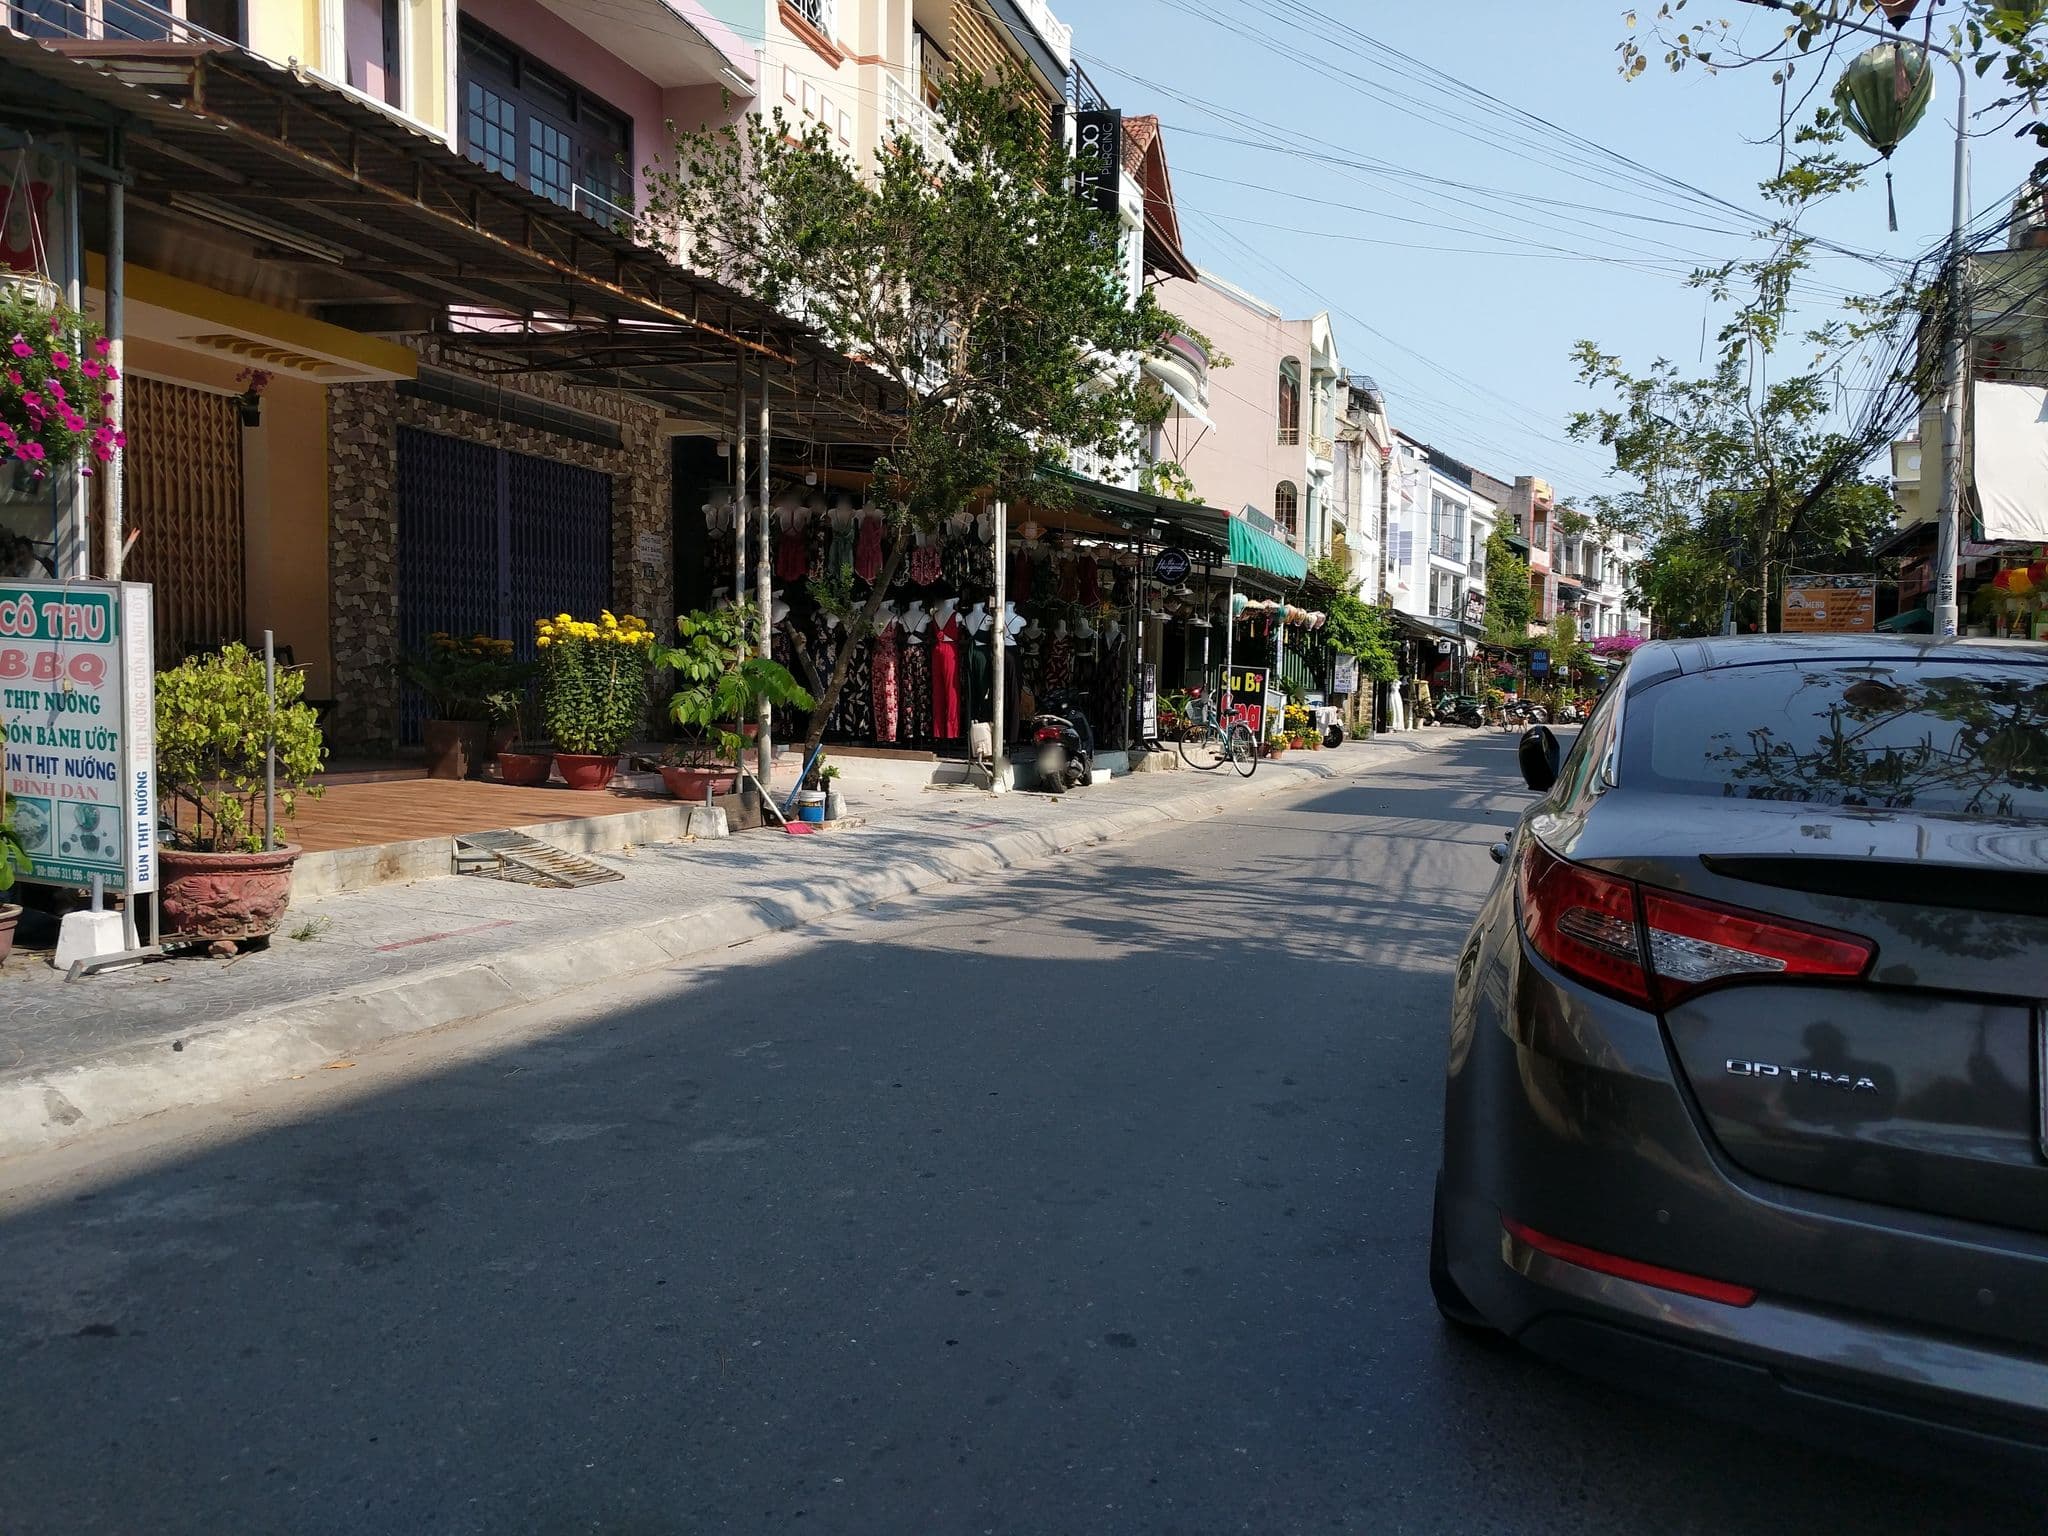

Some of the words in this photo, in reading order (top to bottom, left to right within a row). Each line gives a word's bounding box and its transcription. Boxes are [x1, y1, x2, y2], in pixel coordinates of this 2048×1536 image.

[1102, 122, 1113, 175] PIERCING
[0, 593, 37, 636] CÔ
[42, 602, 105, 640] THU
[0, 649, 107, 690] BBQ
[1221, 671, 1241, 690] Su
[1245, 672, 1262, 693] Bi
[4, 689, 40, 714] THỊT
[36, 721, 81, 749] BÁNH
[85, 726, 118, 752] ƯỚT
[26, 754, 59, 779] THỊT
[65, 755, 116, 781] NƯỚNG
[13, 776, 56, 797] BÌNH
[61, 782, 99, 801] DÂN
[135, 771, 148, 816] NƯỚNG
[138, 821, 151, 850] THỊT
[136, 854, 149, 882] BÚN
[1726, 1058, 1880, 1095] OPTIMA
